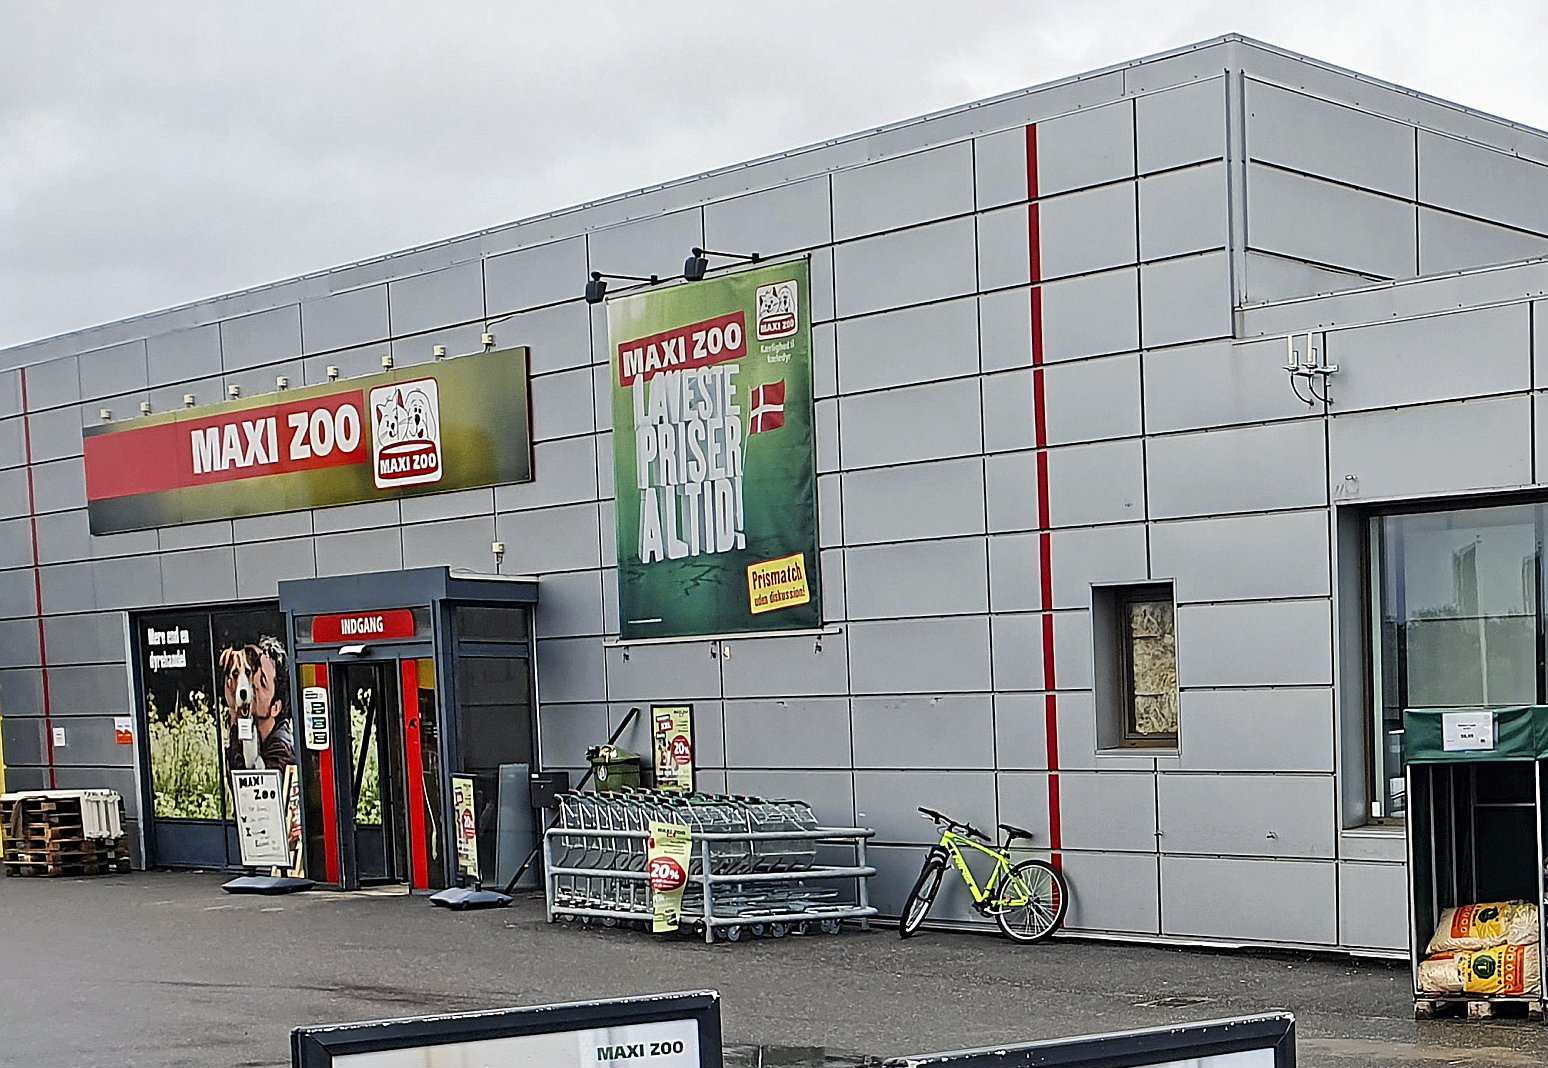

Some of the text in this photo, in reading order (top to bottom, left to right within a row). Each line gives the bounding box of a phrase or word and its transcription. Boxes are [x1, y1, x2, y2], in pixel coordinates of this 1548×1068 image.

[622, 322, 742, 377] MAXI ZOO
[634, 364, 740, 427] LAVESTE
[190, 403, 361, 474] MAXI ZOO
[380, 451, 437, 475] MAXI ZOO
[637, 415, 743, 489] PRISER
[639, 476, 746, 563] ALTID!
[752, 562, 803, 590] Prismatch
[341, 616, 384, 635] INDGANG
[238, 775, 264, 788] MAXI
[253, 789, 276, 800] ZOO
[651, 863, 680, 880] 20%
[597, 1040, 684, 1061] MAXI ZOO
